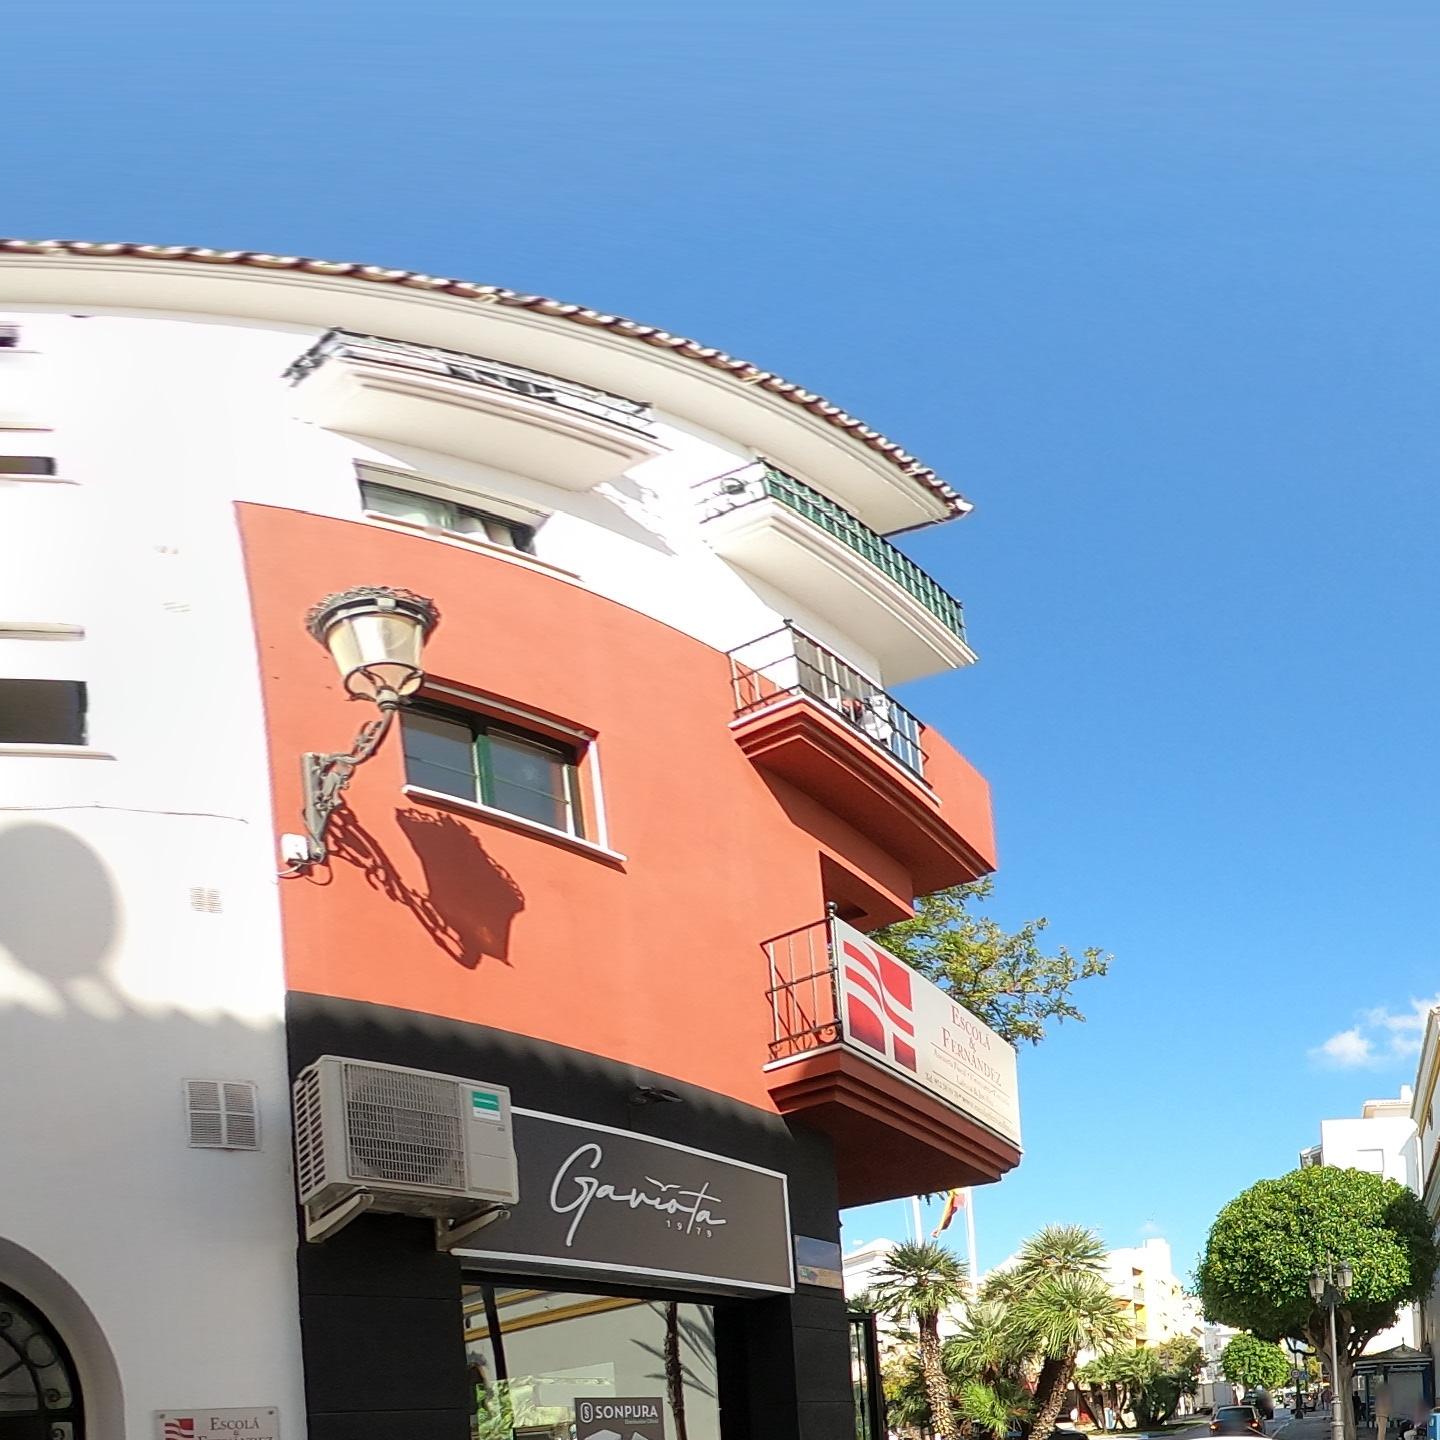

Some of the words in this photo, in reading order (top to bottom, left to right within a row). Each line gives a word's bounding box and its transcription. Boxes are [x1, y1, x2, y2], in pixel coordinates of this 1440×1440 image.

[550, 1143, 726, 1246] Gaviota
[595, 1405, 658, 1419] SONPURA
[210, 1417, 260, 1431] ESCOLÁ
